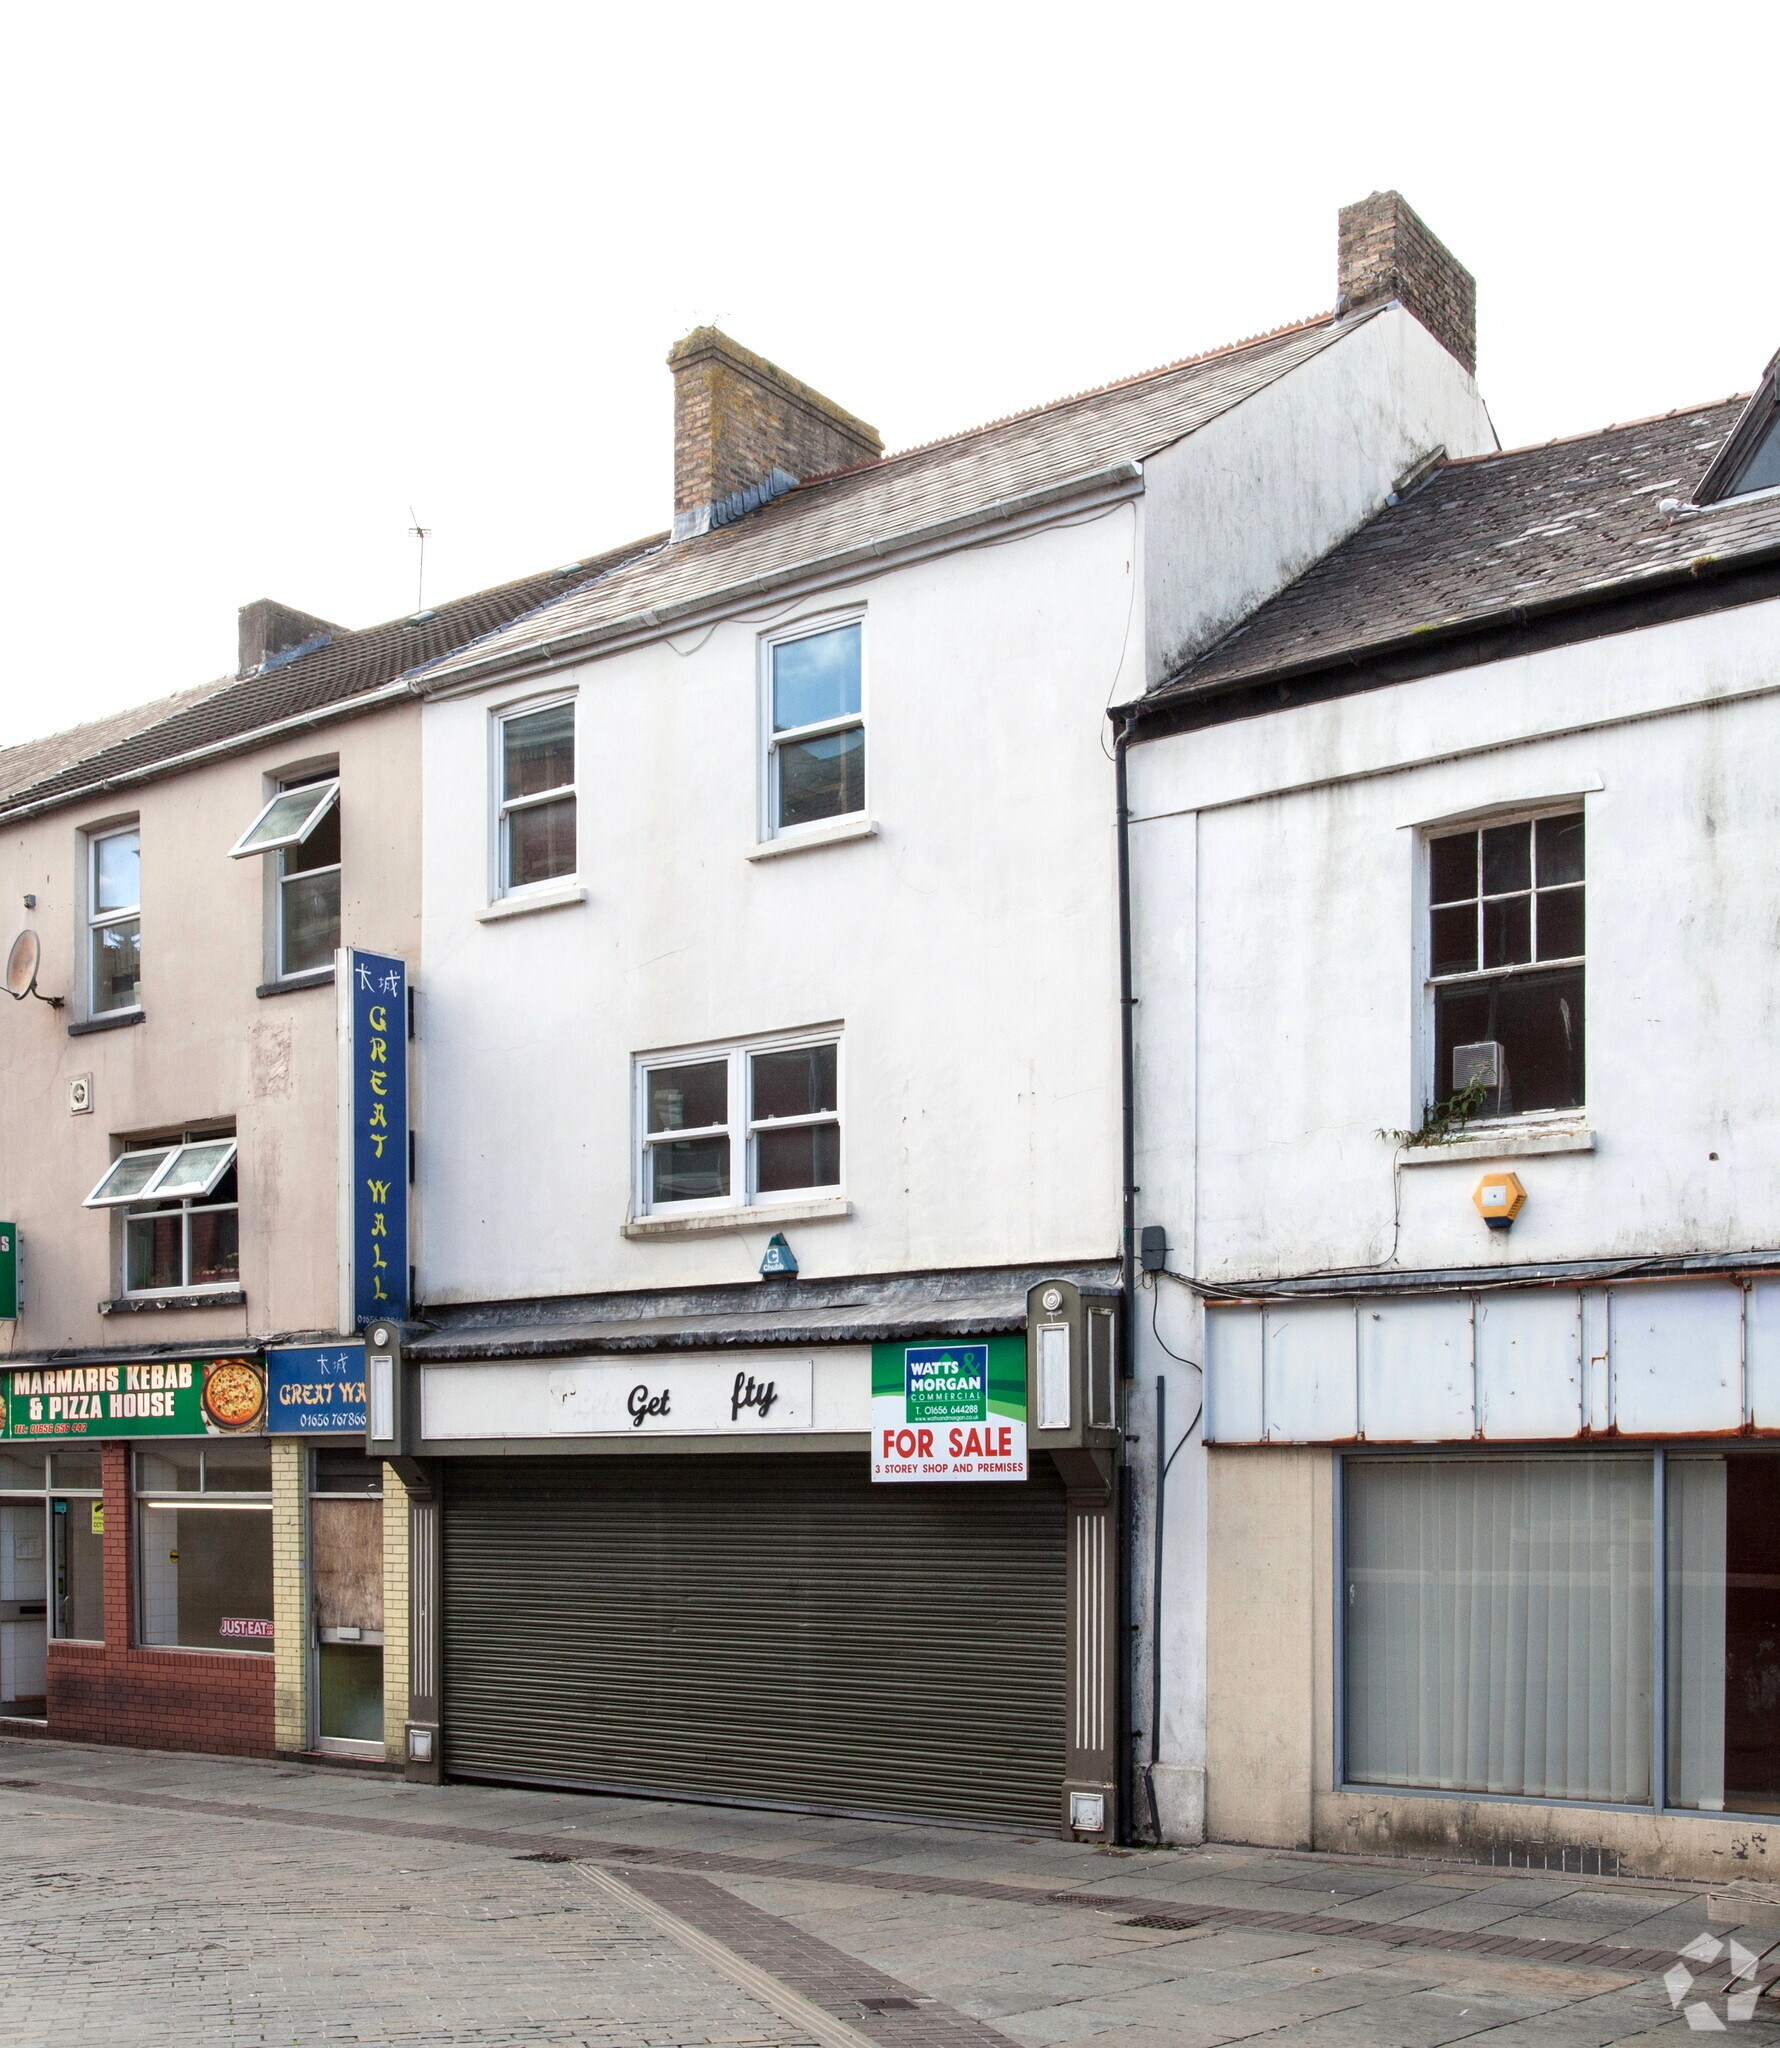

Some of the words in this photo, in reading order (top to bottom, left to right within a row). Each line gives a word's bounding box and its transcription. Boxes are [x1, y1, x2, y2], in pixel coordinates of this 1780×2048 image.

[369, 1005, 388, 1158] GREAT
[367, 1178, 392, 1300] WALL
[911, 1361, 959, 1375] WATTS
[962, 1352, 980, 1376] &
[14, 1367, 119, 1396] MARMARIS
[126, 1363, 193, 1391] KEBAB
[911, 1376, 981, 1392] MORGAN
[29, 1397, 43, 1421] &
[49, 1394, 103, 1420] PIZZA
[109, 1391, 175, 1418] HOUSE
[279, 1382, 335, 1406] GREAT
[627, 1384, 671, 1427] Get
[731, 1371, 778, 1421] fty
[911, 1392, 980, 1401] COMMERCIAL
[300, 1413, 329, 1427] 01656
[332, 1411, 367, 1426] 767866
[924, 1405, 948, 1415] 01656
[950, 1404, 979, 1414] 644288
[883, 1428, 934, 1459] FOR
[948, 1426, 1012, 1458] SALE
[875, 1464, 881, 1474] 3
[884, 1464, 918, 1474] STOREY
[922, 1464, 948, 1473] SHOP
[952, 1463, 973, 1473] AND
[978, 1462, 1024, 1472] PREMISES
[221, 1620, 247, 1634] JUST
[247, 1621, 268, 1636] EAT
